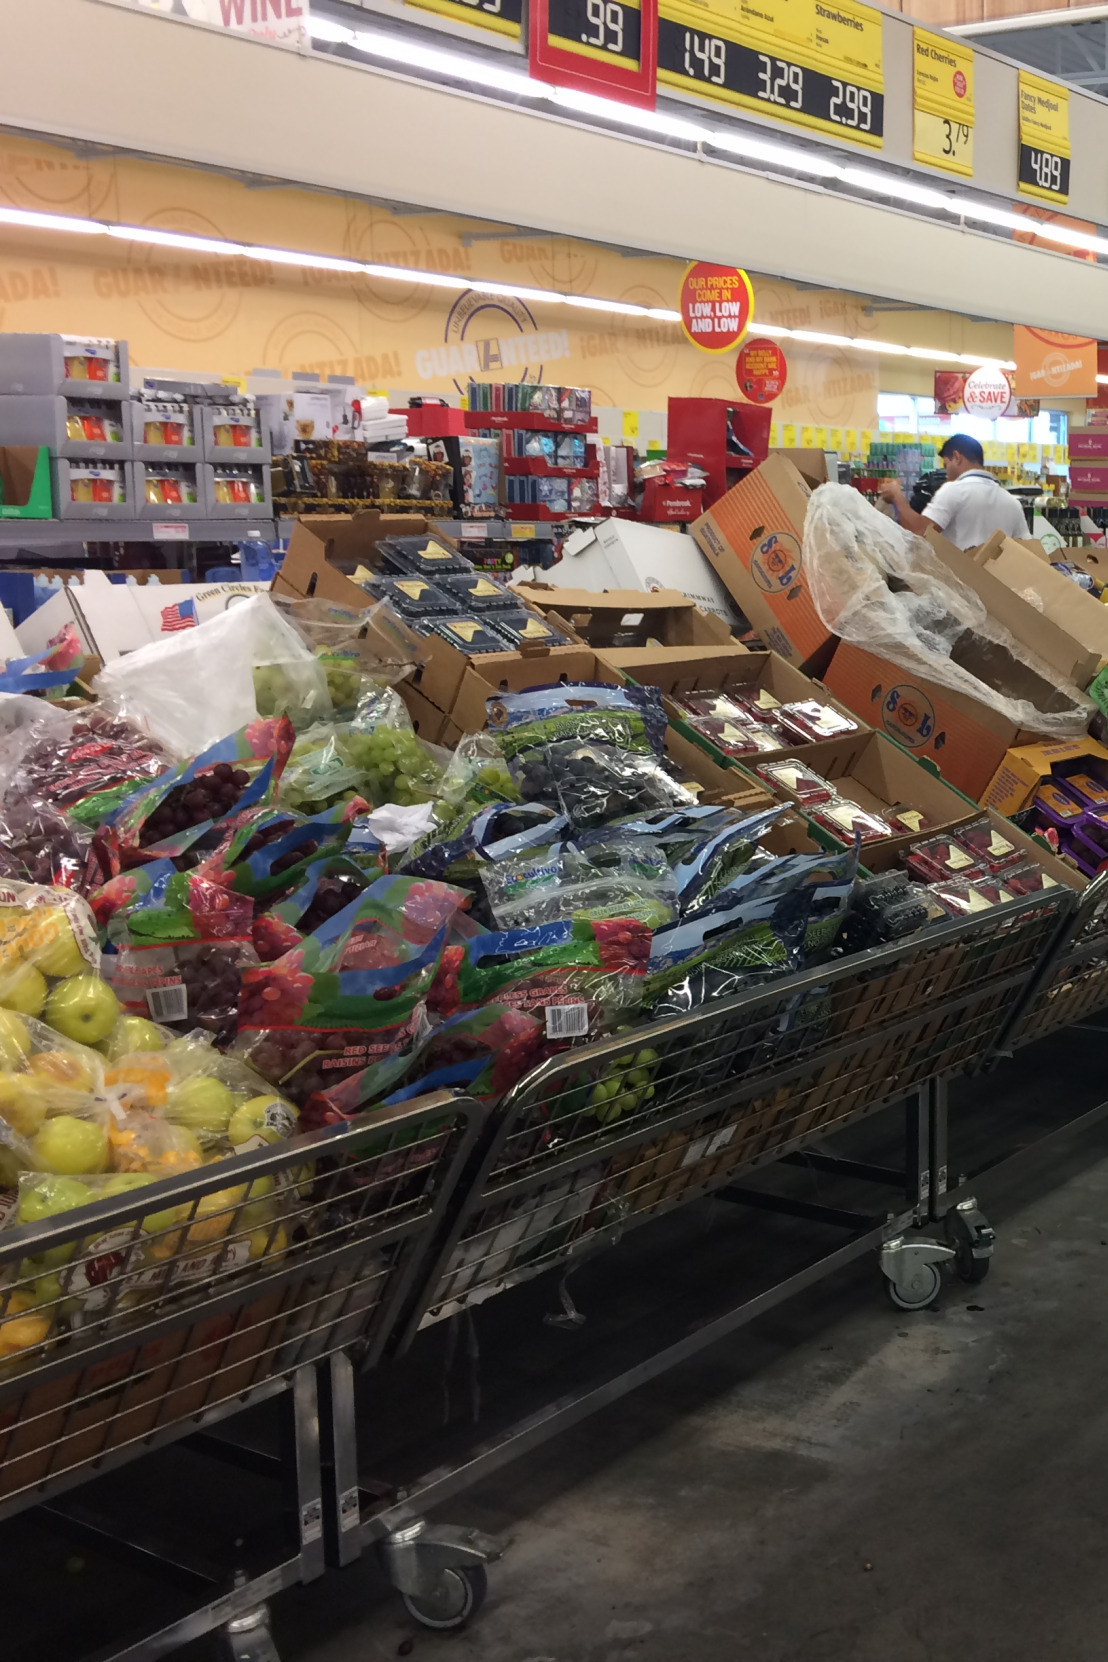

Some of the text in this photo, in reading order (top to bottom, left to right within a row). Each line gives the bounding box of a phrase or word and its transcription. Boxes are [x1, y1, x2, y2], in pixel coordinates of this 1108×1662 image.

[814, 4, 864, 32] Strawberries
[684, 31, 726, 85] 1.49
[916, 43, 957, 68] Red Cherries
[757, 54, 803, 109] 3.29
[1021, 89, 1036, 104] Fancy
[829, 79, 872, 131] 2.99
[1031, 150, 1061, 191] 4.89
[688, 275, 740, 289] OUR PRICES
[695, 289, 732, 301] COME IN
[688, 301, 740, 318] LOW, LOW
[690, 317, 740, 333] AND LOW
[967, 380, 1007, 391] Celebrate
[967, 390, 1007, 404] & SAVE
[195, 587, 221, 602] Green
[220, 583, 252, 593] Circles
[343, 1046, 366, 1056] RED
[322, 1056, 366, 1069] RAISINS
